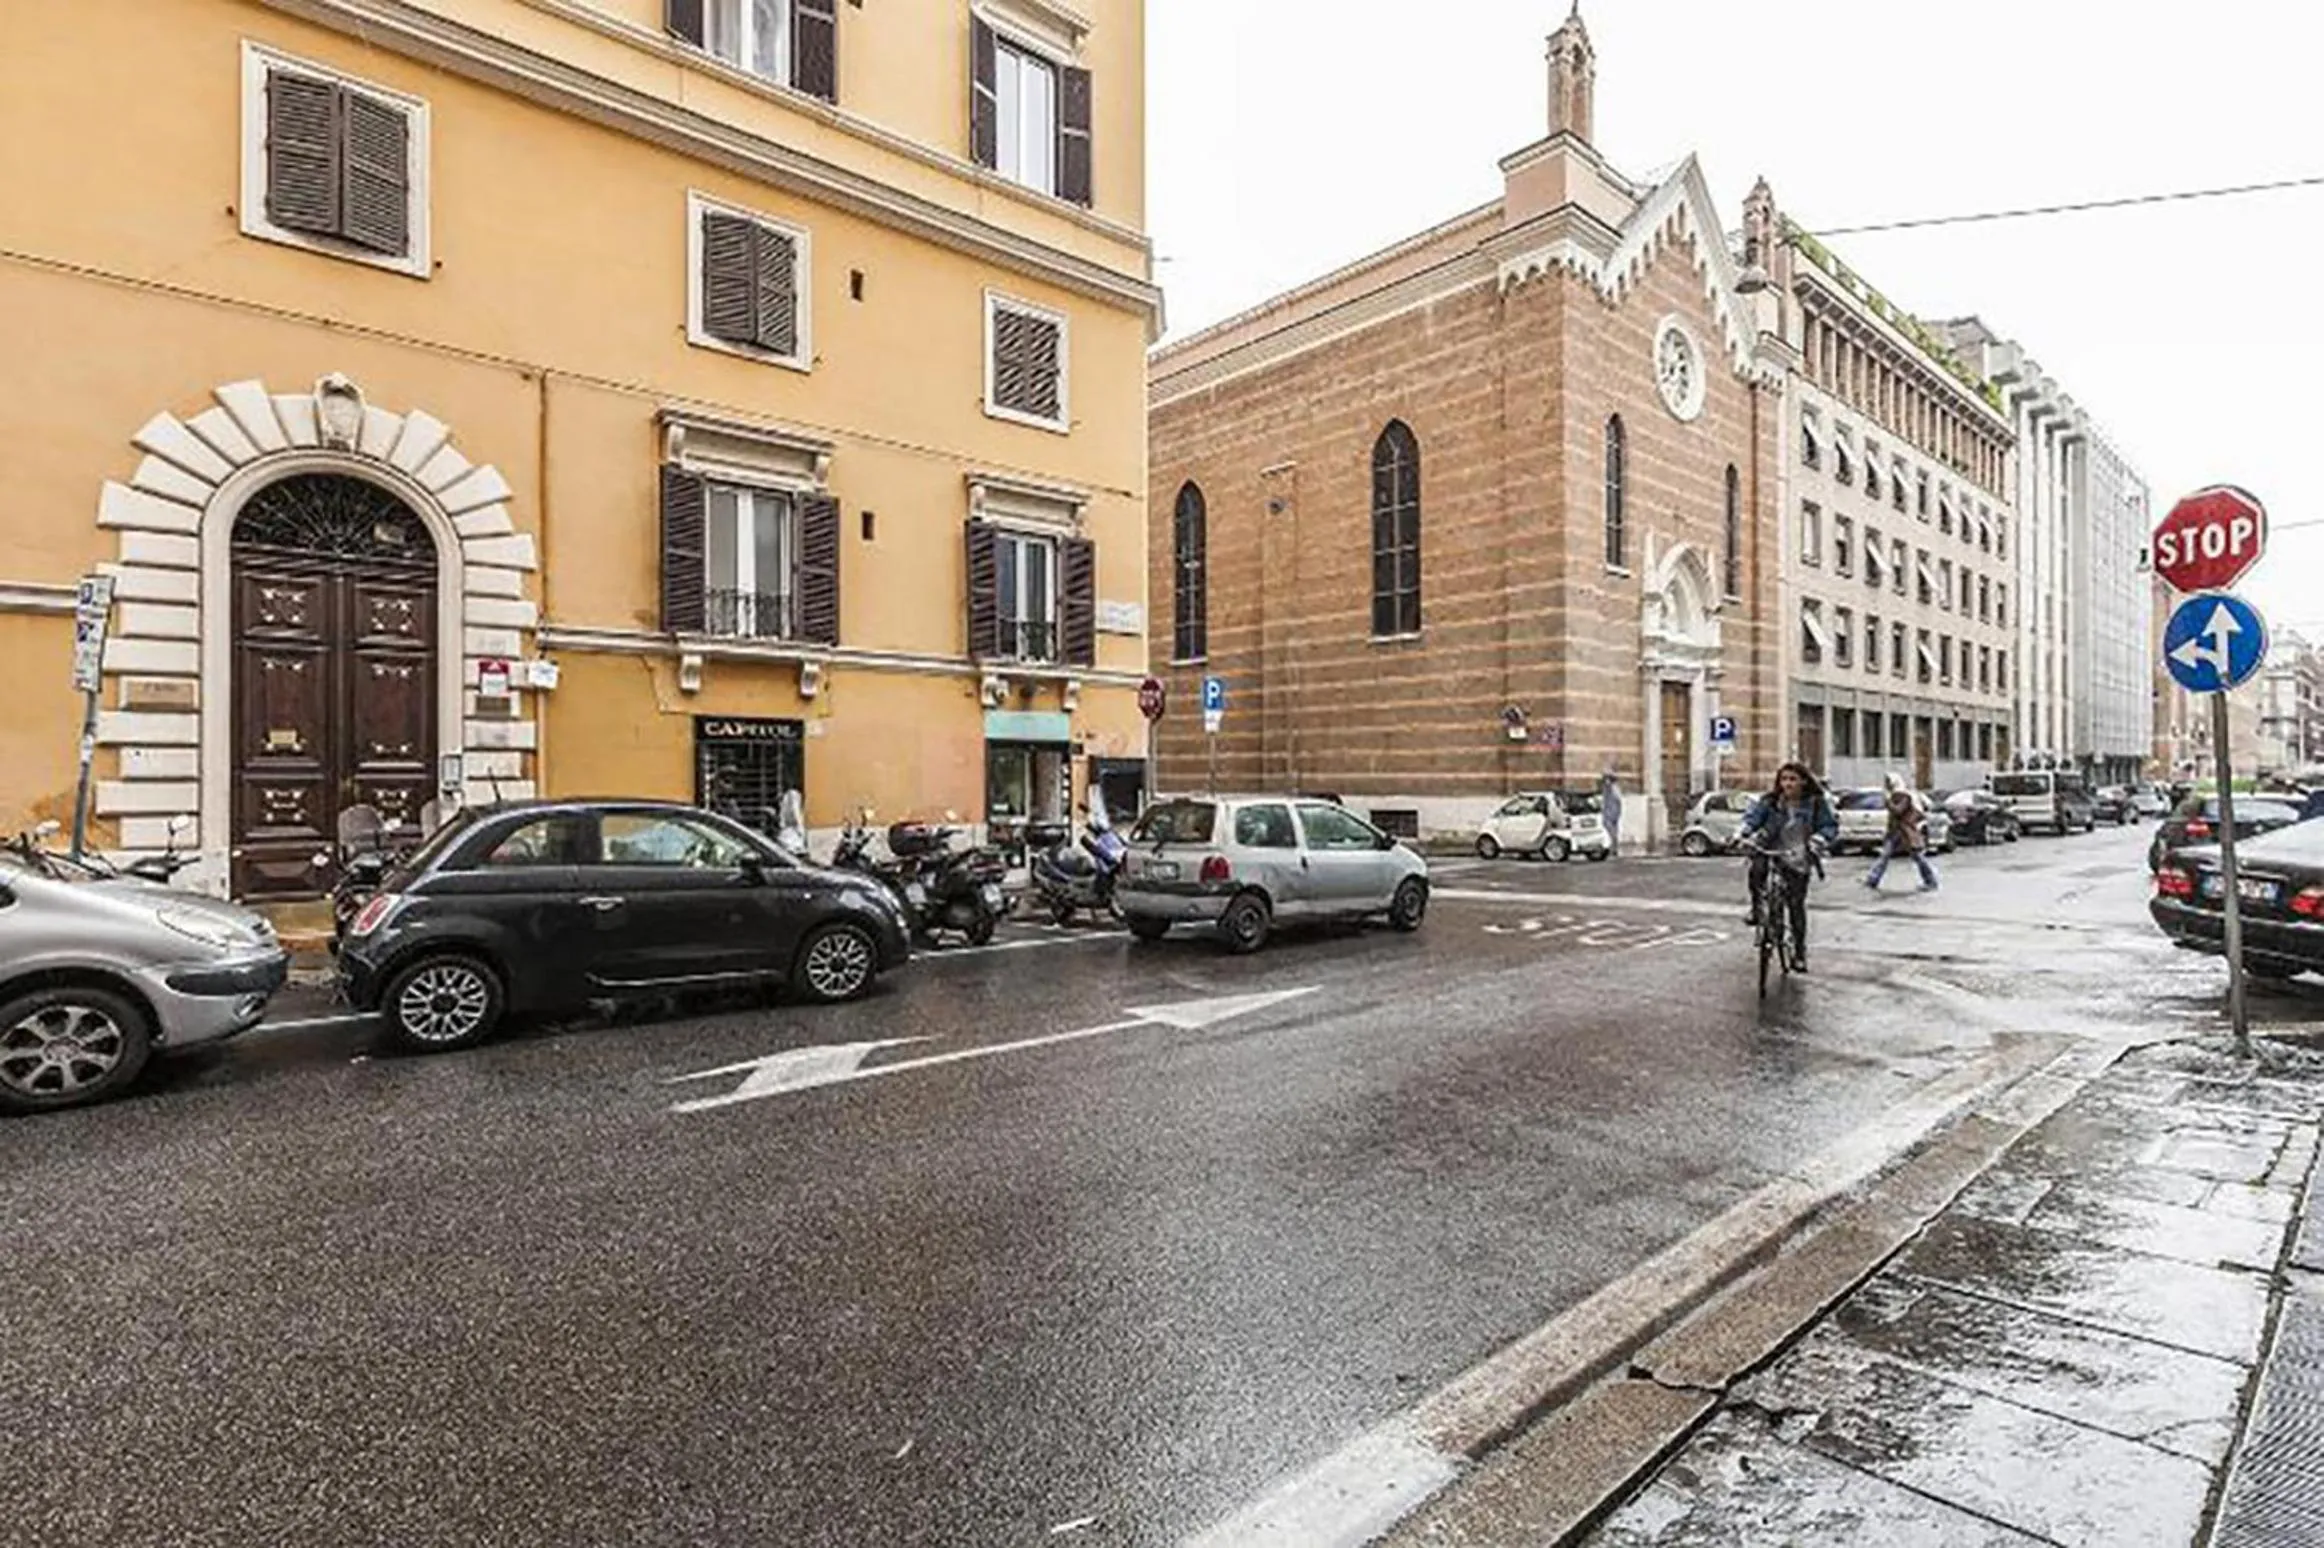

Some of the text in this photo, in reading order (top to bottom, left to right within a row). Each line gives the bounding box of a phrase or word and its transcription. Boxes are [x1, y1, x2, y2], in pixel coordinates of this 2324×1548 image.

[2158, 516, 2254, 568] STOP
[1207, 680, 1221, 706] P
[704, 721, 798, 738] CAPITOL
[1715, 718, 1731, 738] P
